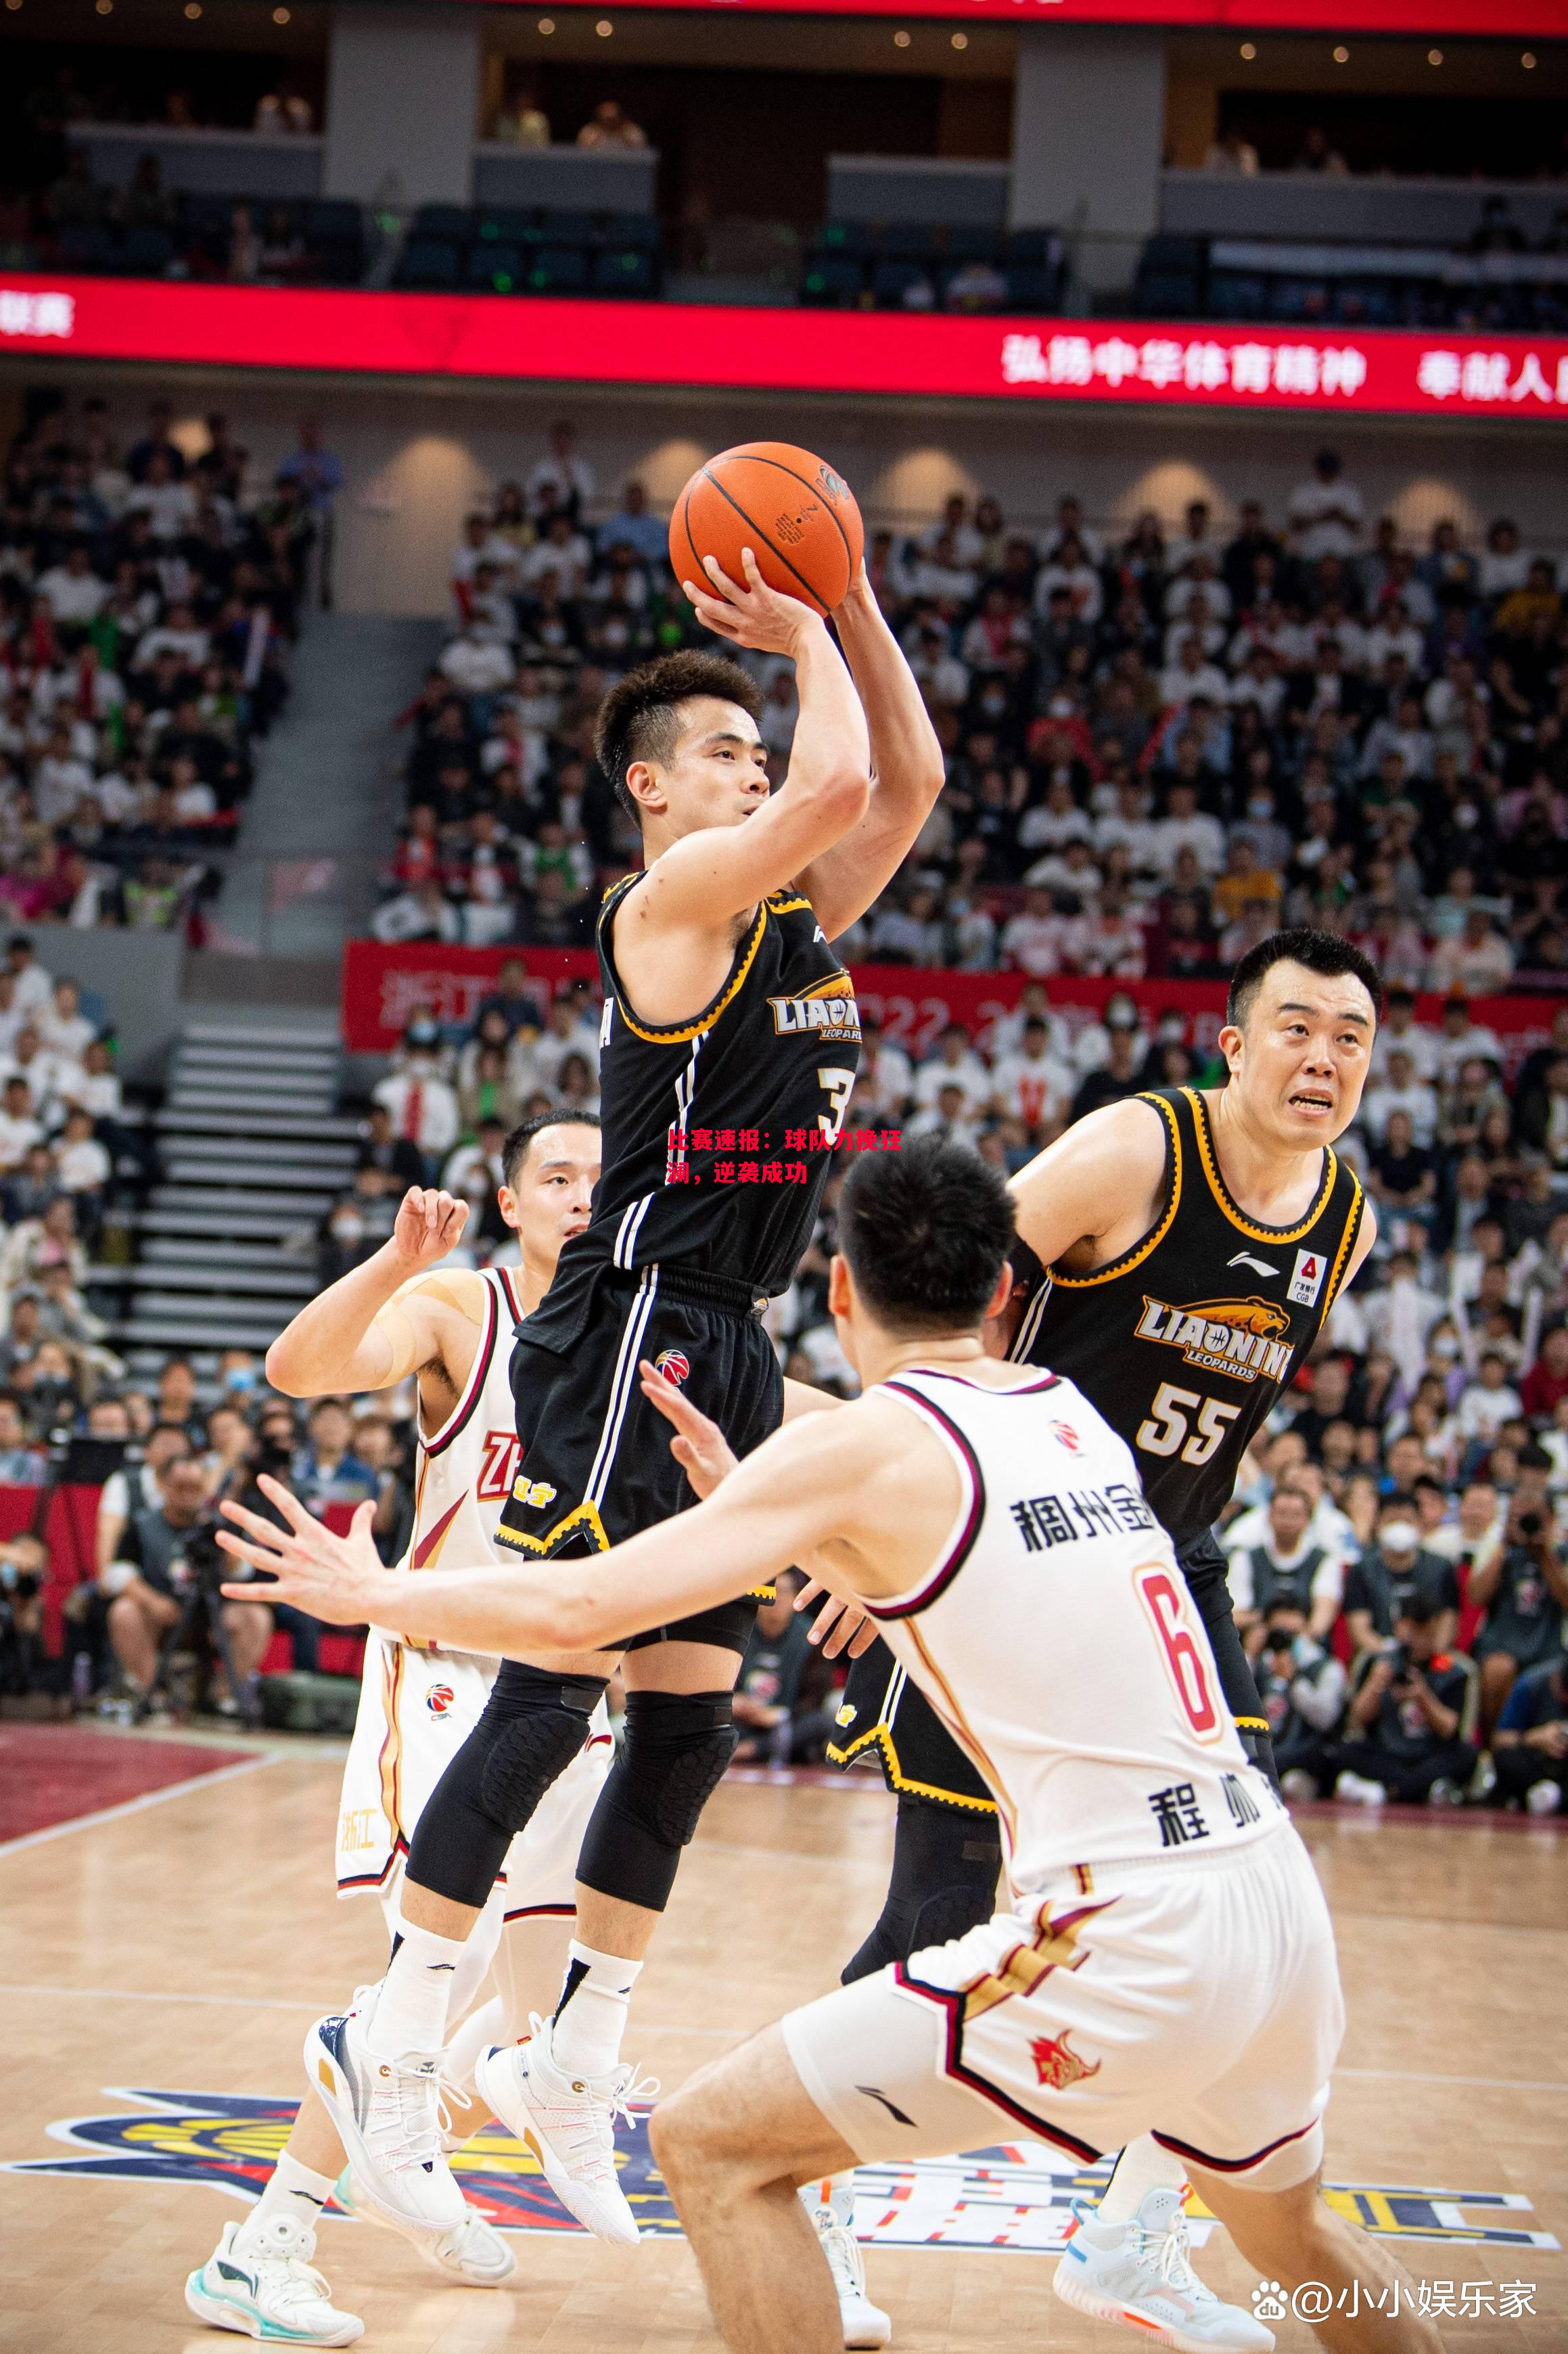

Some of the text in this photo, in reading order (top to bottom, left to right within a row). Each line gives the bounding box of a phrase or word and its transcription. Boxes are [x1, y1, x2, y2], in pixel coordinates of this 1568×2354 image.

[1000, 334, 1568, 404] 弘扬中华体育精神 奉献人
[816, 1068, 856, 1146] 3
[1296, 1292, 1310, 1303] CGB
[1186, 1349, 1256, 1380] LEOPARDS
[1136, 1382, 1243, 1466] 55
[1138, 1568, 1220, 1739] 6
